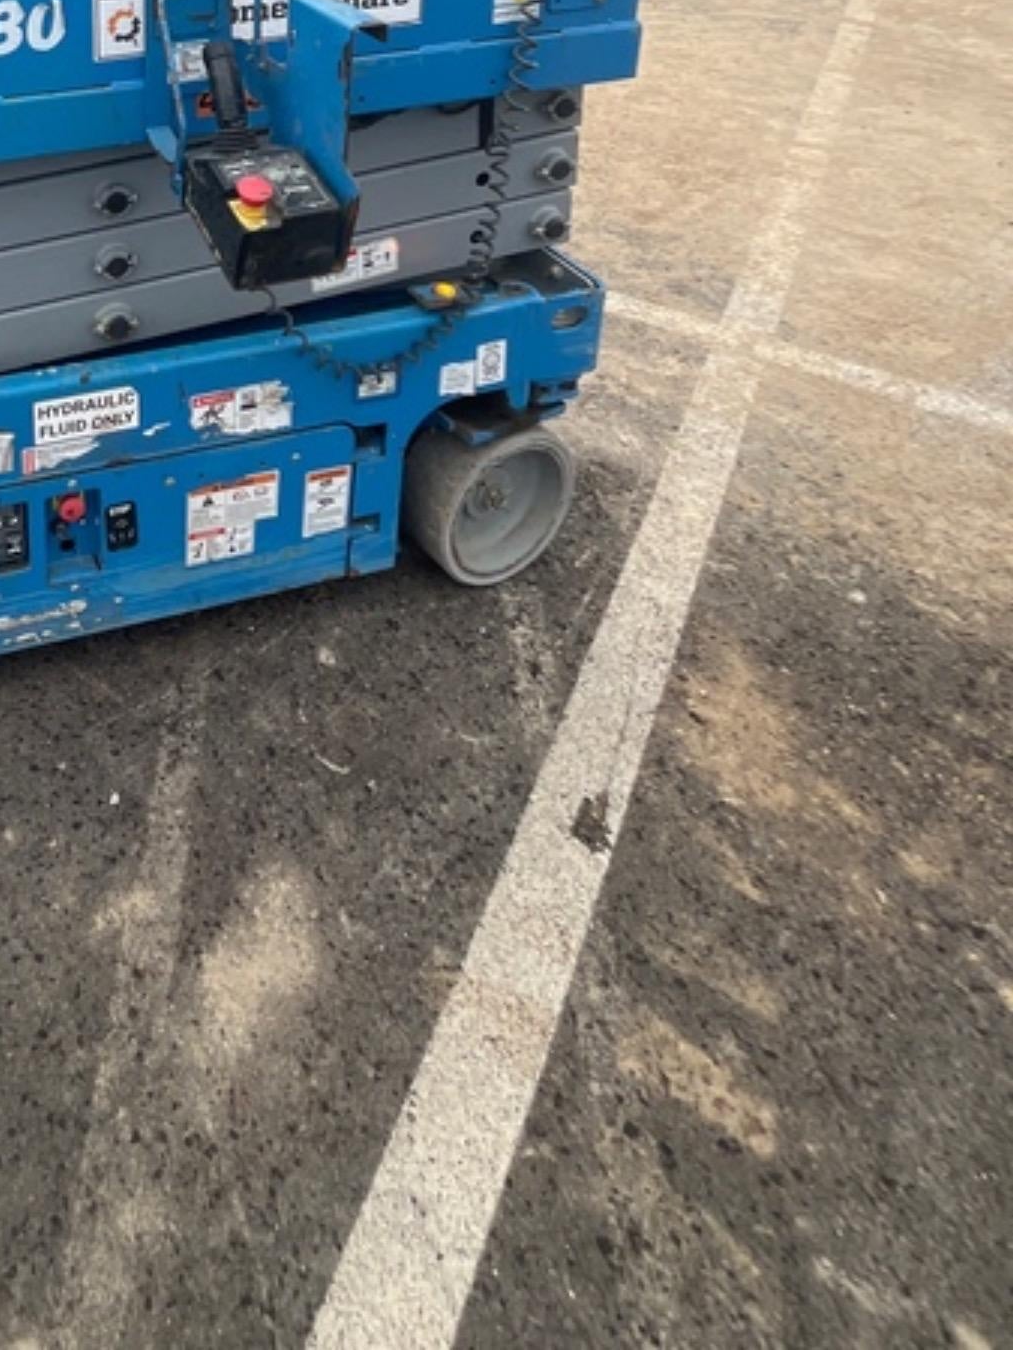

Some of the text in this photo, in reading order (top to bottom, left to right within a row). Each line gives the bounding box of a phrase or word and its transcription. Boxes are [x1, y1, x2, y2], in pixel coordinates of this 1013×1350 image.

[37, 392, 135, 420] HYDRAULIC
[39, 410, 134, 438] FLUID ONLY
